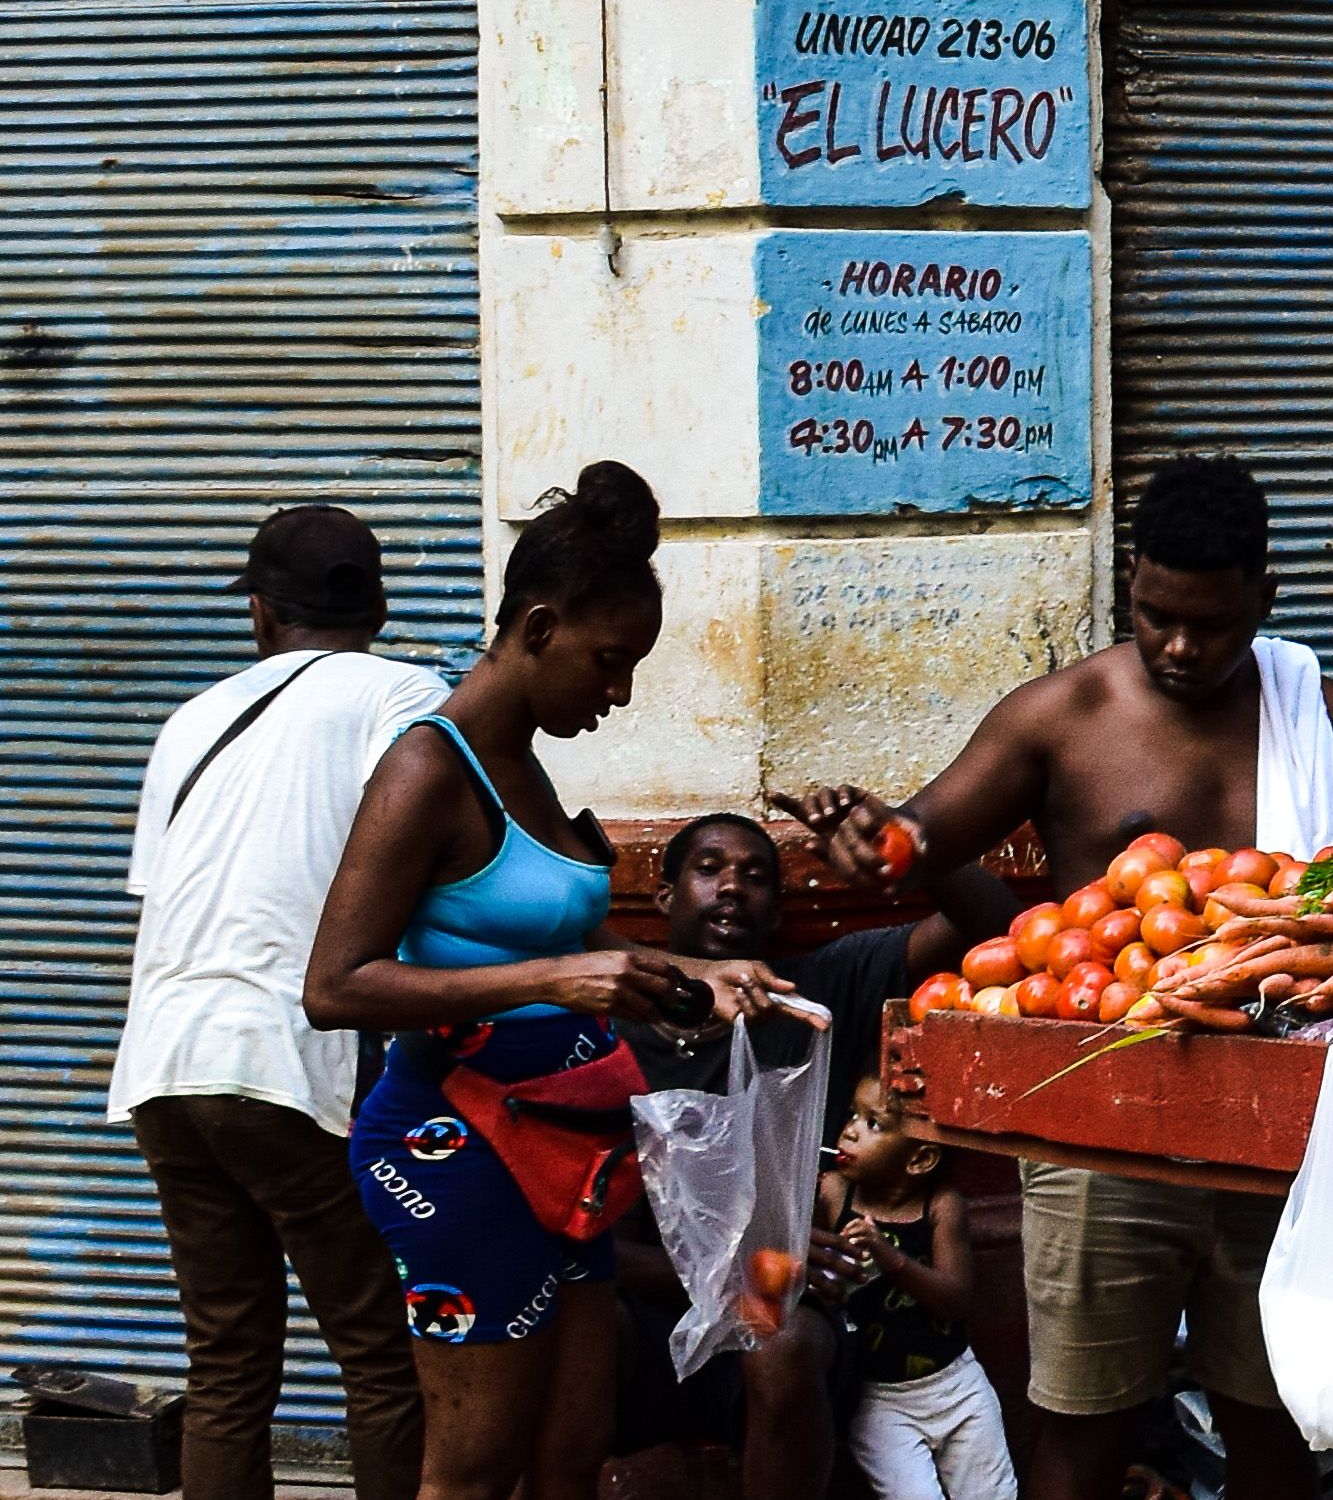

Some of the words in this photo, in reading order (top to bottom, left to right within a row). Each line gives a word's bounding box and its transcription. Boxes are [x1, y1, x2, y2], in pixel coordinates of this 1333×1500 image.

[795, 12, 931, 57] UNIDAD
[838, 260, 1002, 302] HORARIO
[804, 306, 832, 338] de
[840, 310, 908, 334] LUNES
[911, 313, 932, 334] A
[937, 310, 1022, 335] SABADO
[901, 359, 929, 392] A
[901, 417, 930, 450] A
[369, 1157, 436, 1219] GUCCI
[506, 1274, 558, 1339] GUCCI
